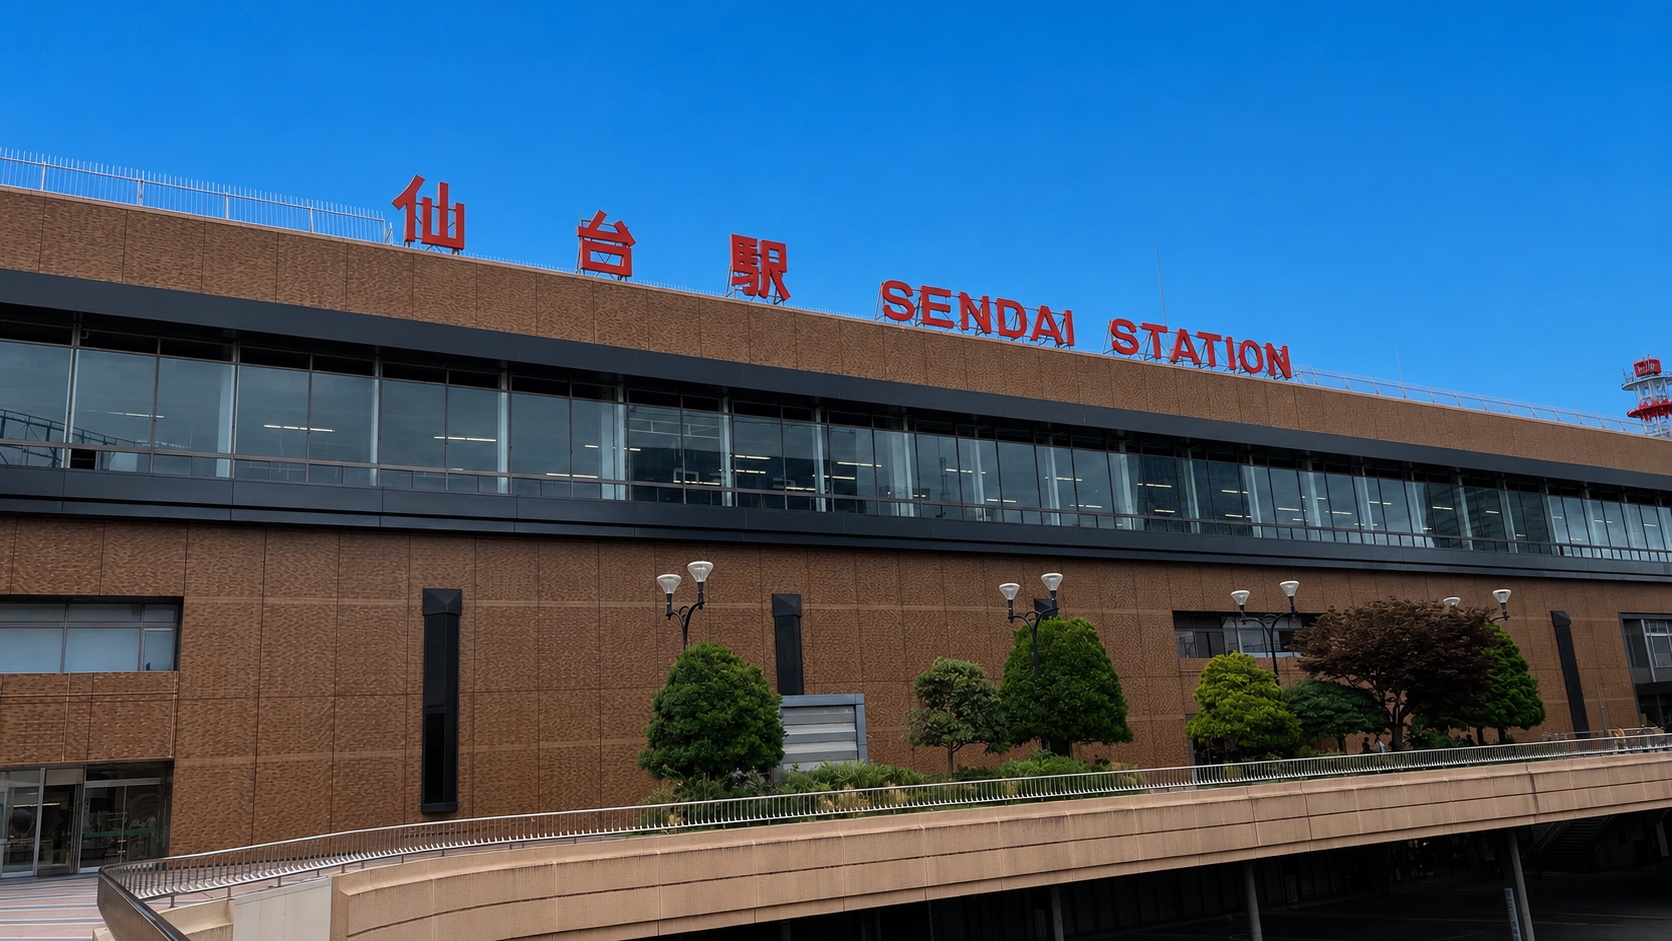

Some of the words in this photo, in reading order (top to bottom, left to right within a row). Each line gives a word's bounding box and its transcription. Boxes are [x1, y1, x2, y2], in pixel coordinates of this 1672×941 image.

[391, 174, 791, 301] 仙台駅
[881, 280, 1075, 347] SENDAI
[1110, 318, 1292, 379] STATION
